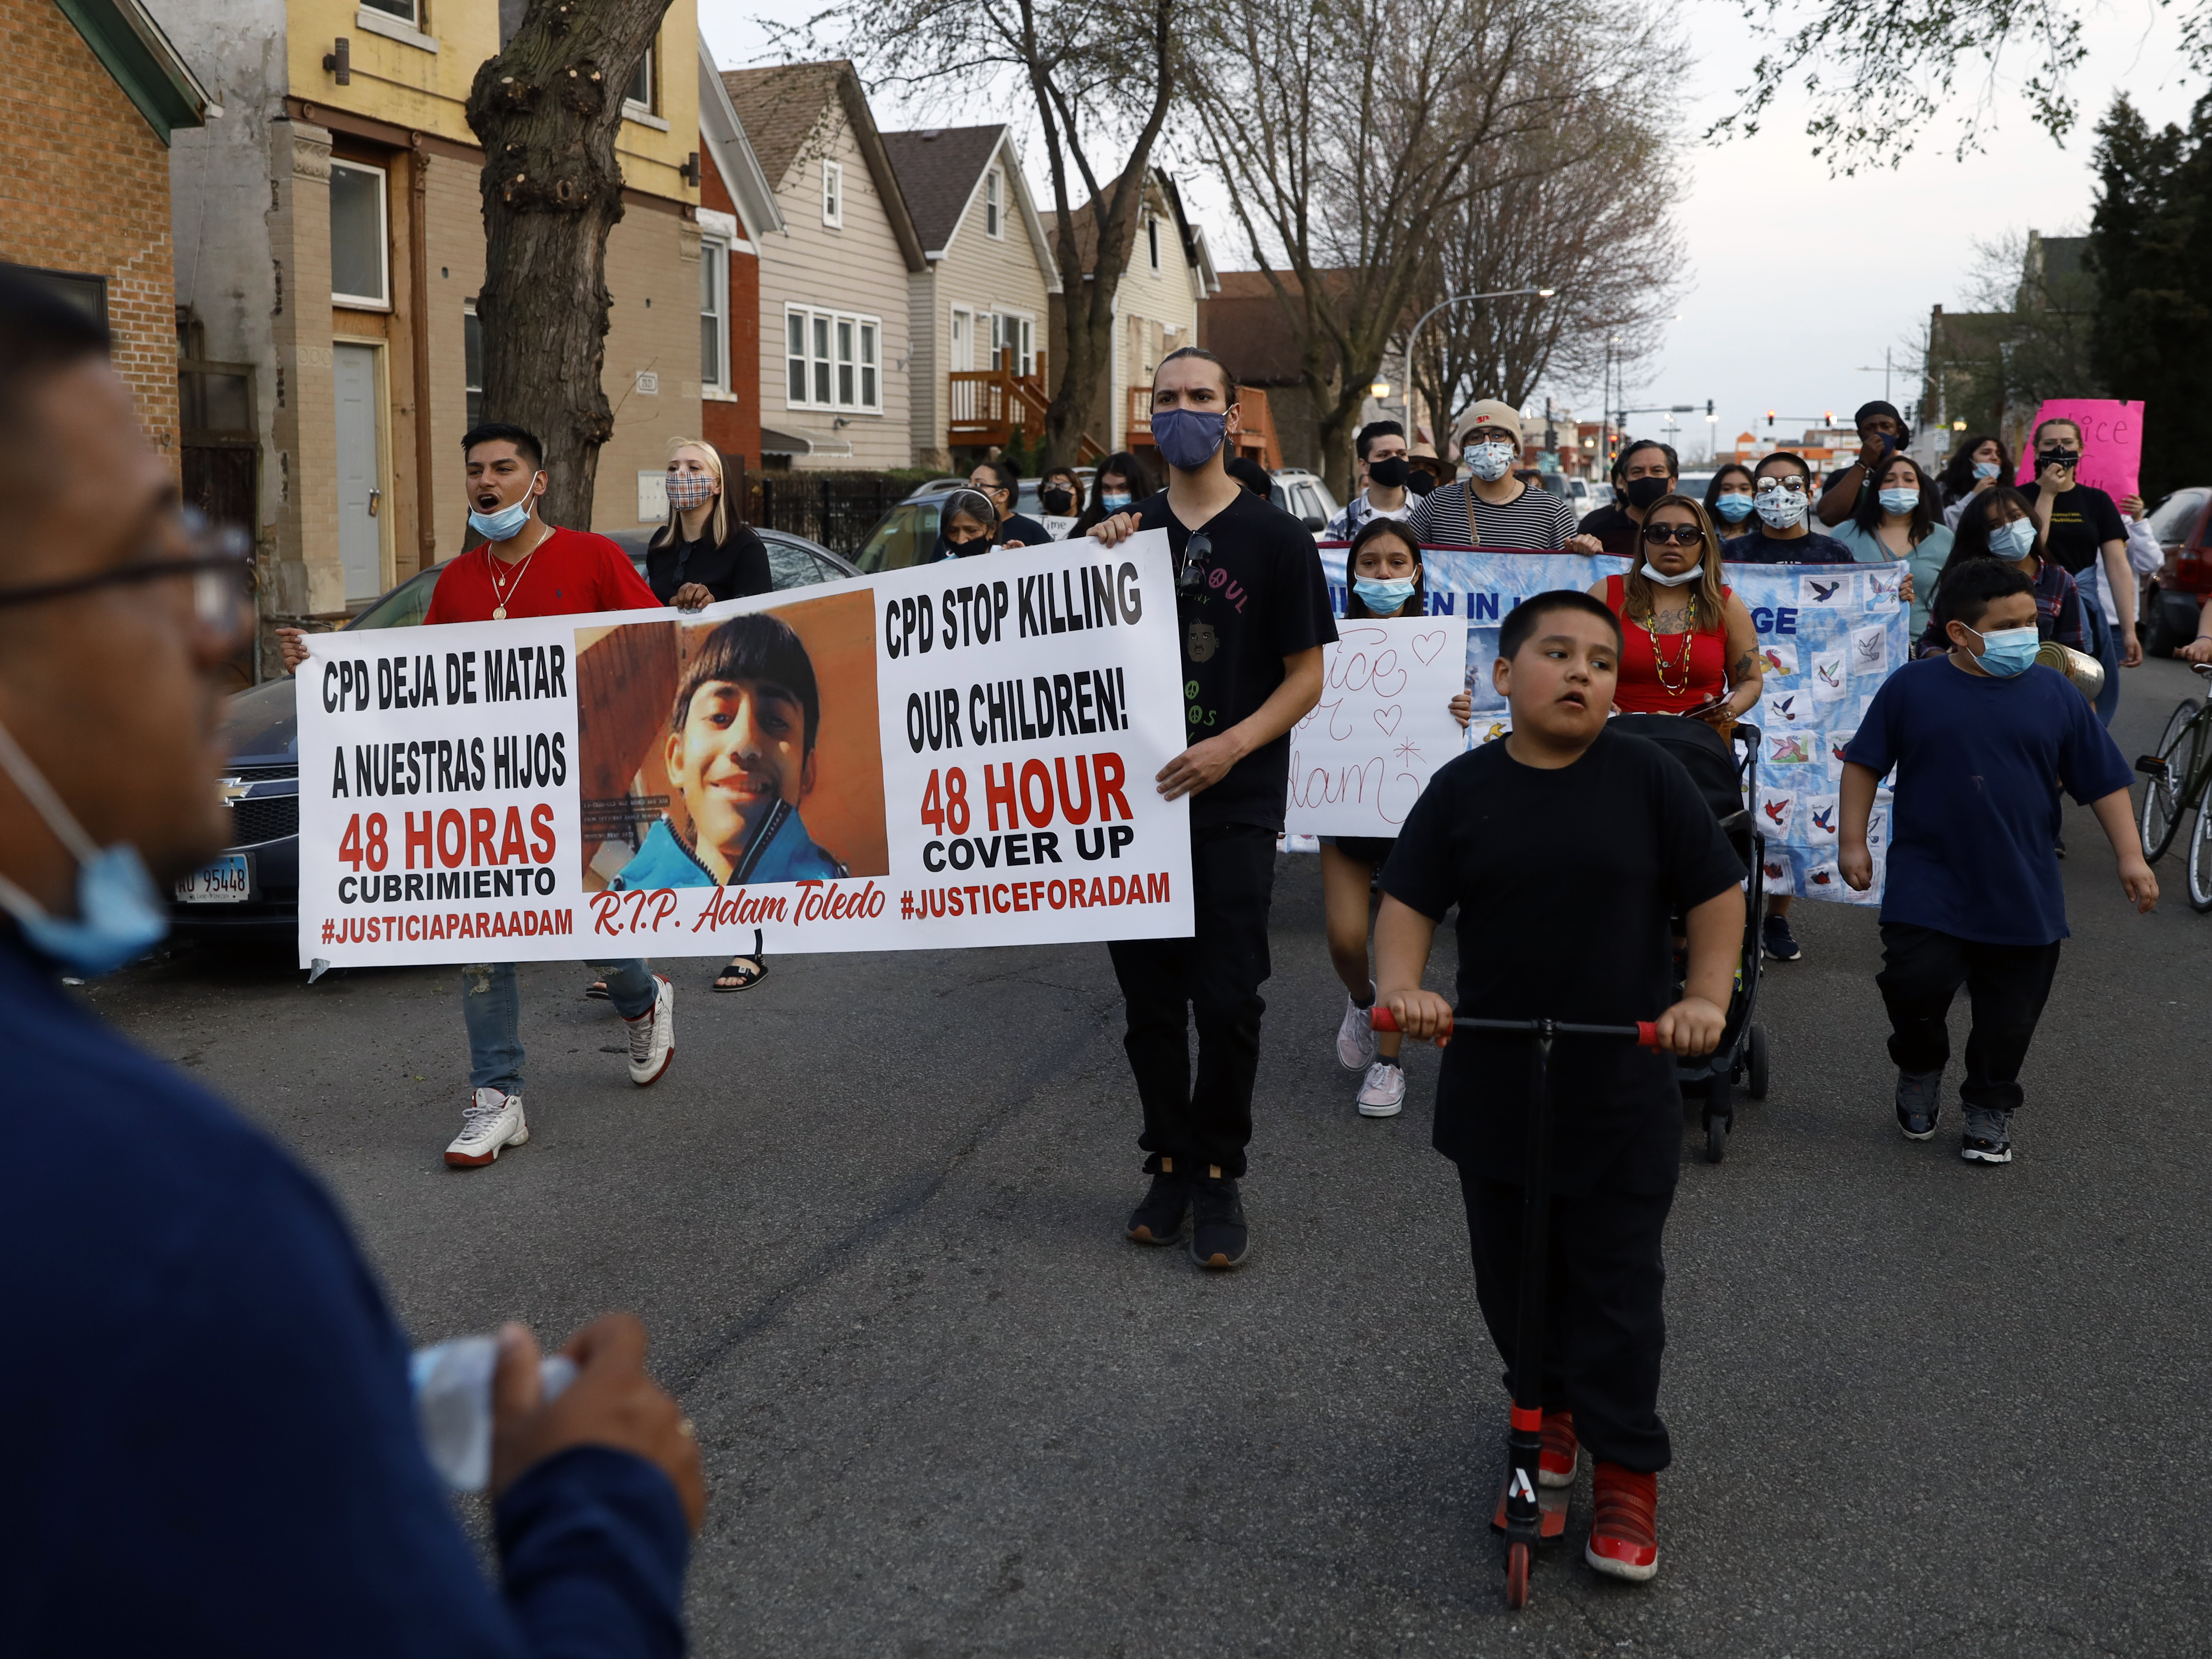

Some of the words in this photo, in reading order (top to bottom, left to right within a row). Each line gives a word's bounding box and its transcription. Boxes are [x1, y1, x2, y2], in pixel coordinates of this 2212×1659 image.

[2070, 413, 2129, 444] ice
[1038, 516, 1066, 530] Time
[886, 594, 933, 659] CPD
[942, 581, 1008, 650] STOP
[1018, 562, 1142, 638] KILLING
[1467, 592, 1498, 620] IN
[323, 661, 369, 713] CPD
[378, 655, 438, 710] DEJA
[446, 651, 477, 705] DE
[484, 645, 567, 703] MATAR
[1322, 638, 1407, 697] ice
[907, 688, 963, 754] OUR
[969, 667, 1129, 746] CHILDREN!
[332, 746, 349, 798] A
[356, 737, 485, 797] NUESTRAS
[494, 732, 566, 789] HIJOS
[920, 767, 970, 836] 48
[984, 752, 1134, 832] HOUR
[1286, 751, 1410, 824] dam
[339, 812, 388, 872] 48
[405, 803, 556, 869] HORAS
[923, 832, 1063, 873] COVER
[1075, 825, 1134, 861] UP
[204, 868, 245, 892] 95448
[338, 867, 555, 904] CUBRIMIENTO
[589, 888, 681, 937] R.I.P.
[691, 885, 788, 933] Adam
[793, 879, 885, 927] Toledo
[901, 872, 1170, 920] #JUSTICEFORADAM
[321, 909, 572, 944] #JUSTICIAPARAADAM
